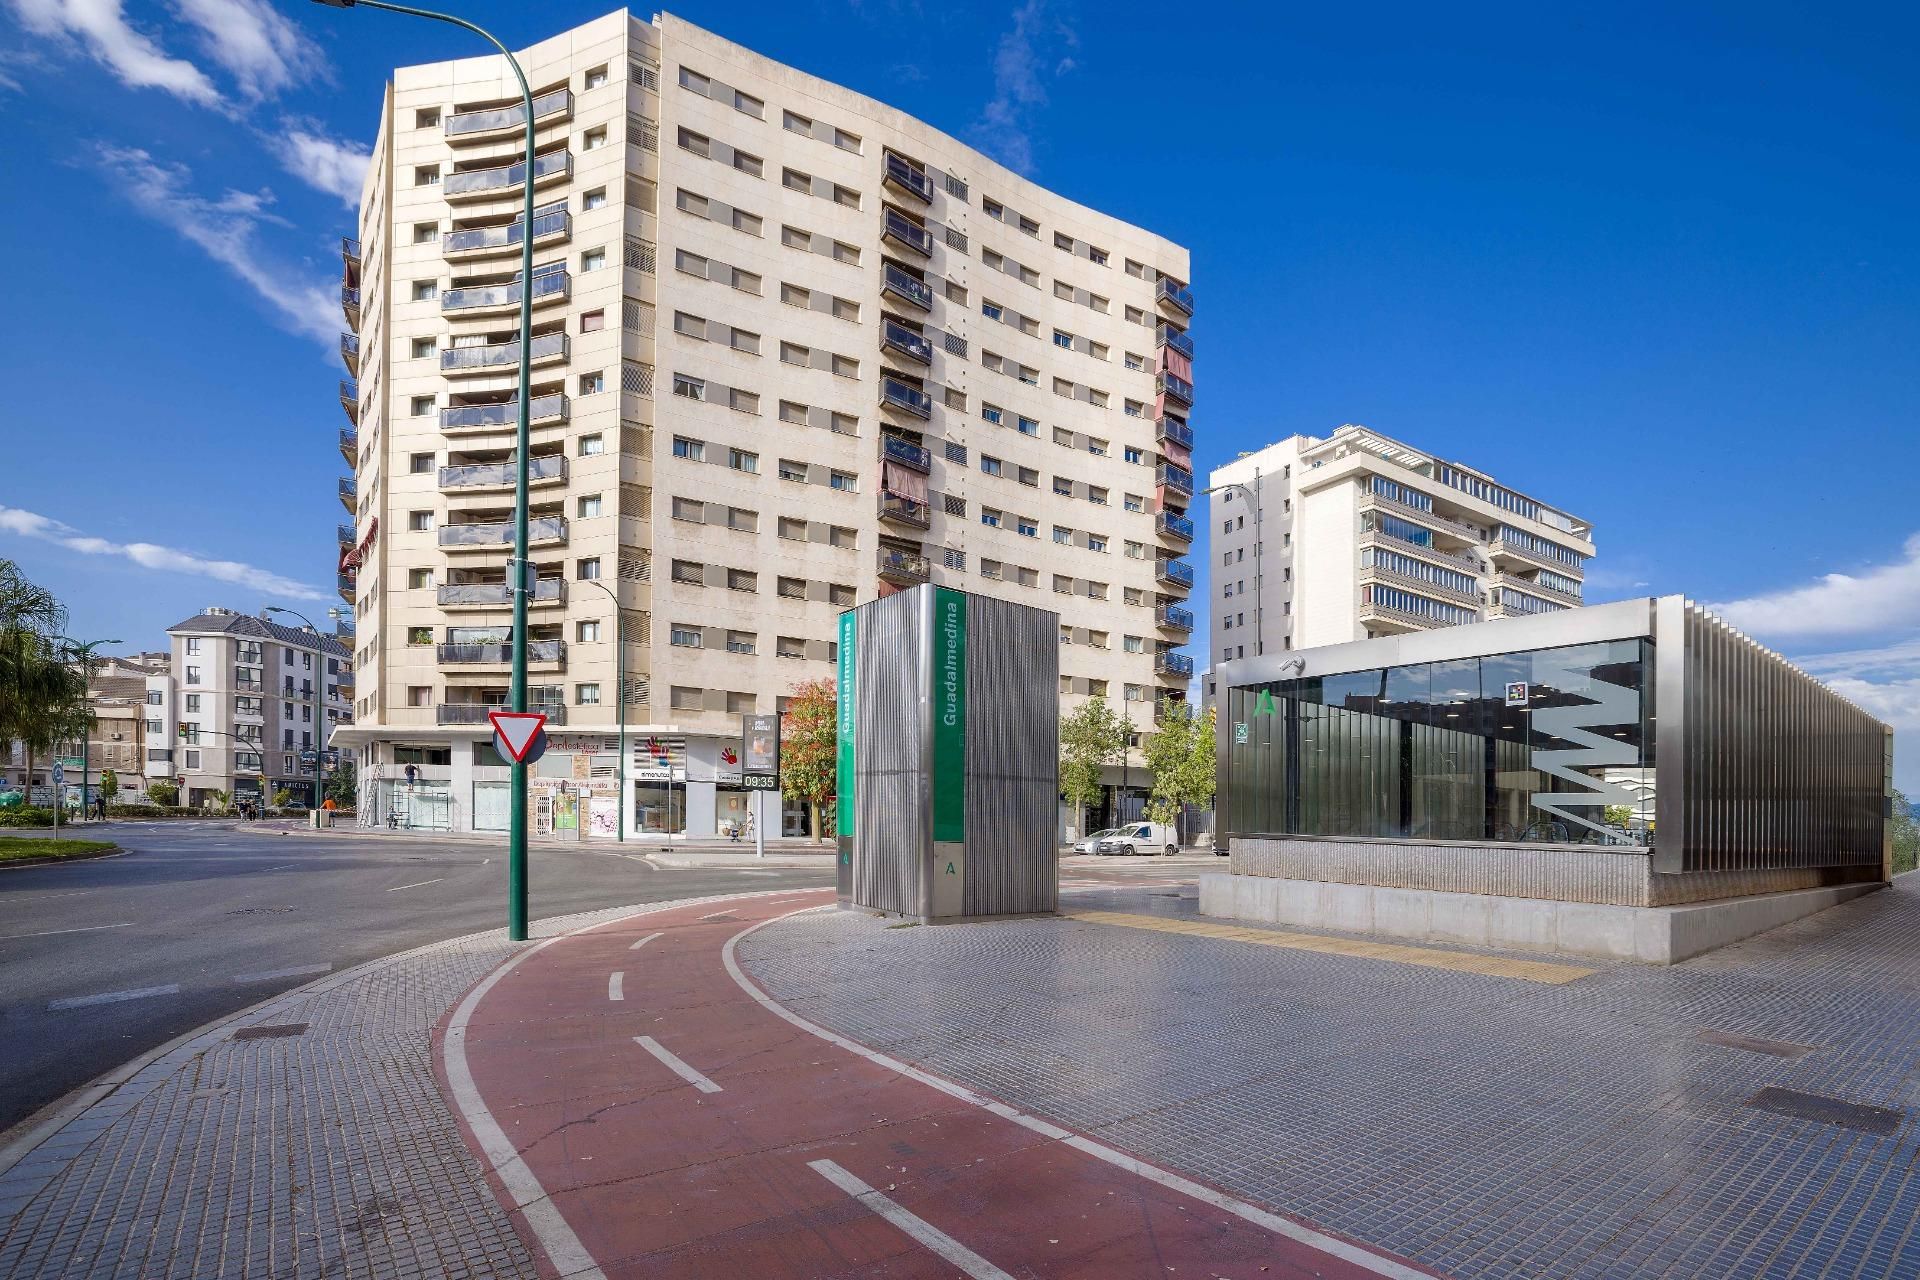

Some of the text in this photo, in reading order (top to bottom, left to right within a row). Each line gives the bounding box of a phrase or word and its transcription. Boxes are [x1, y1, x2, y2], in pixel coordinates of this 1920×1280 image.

[842, 622, 851, 734] Guadalmedina
[943, 602, 957, 726] Guadalmedina
[745, 776, 774, 788] 09:35
